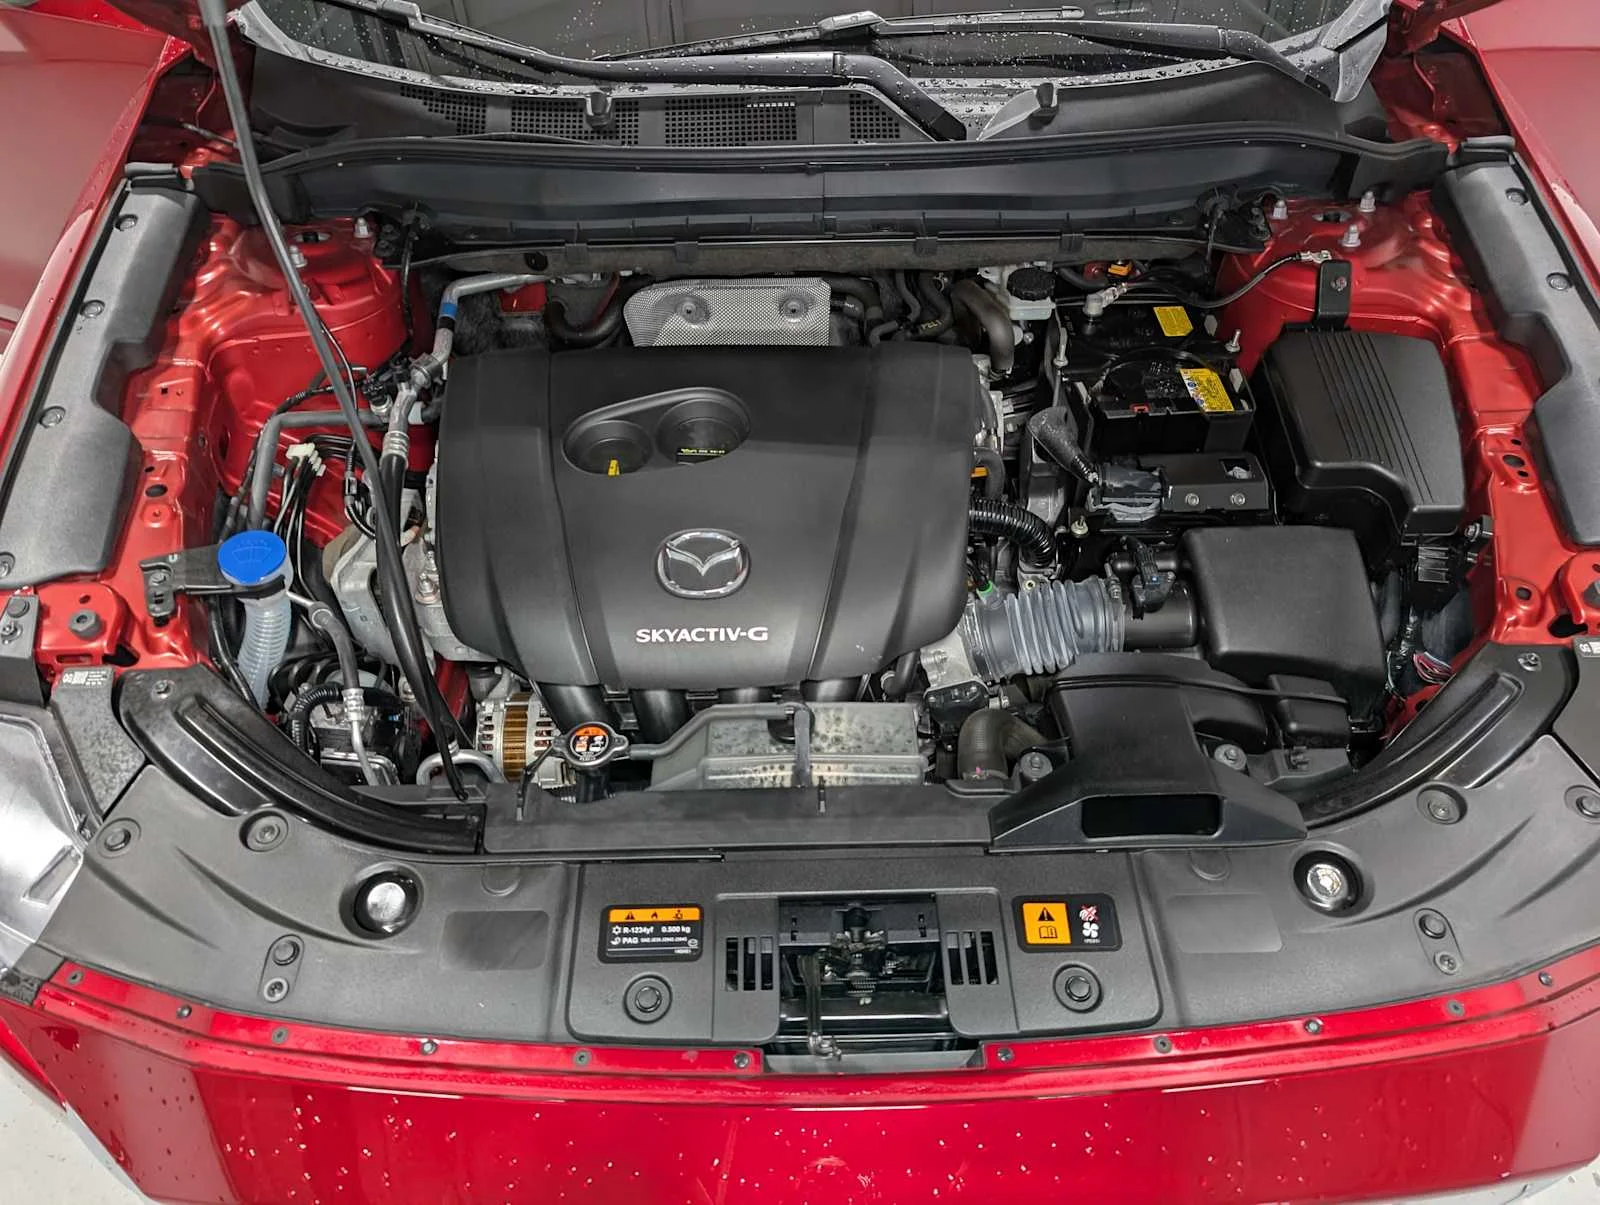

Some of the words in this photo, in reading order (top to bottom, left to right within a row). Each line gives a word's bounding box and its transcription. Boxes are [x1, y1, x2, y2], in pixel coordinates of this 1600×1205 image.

[636, 627, 769, 643] SKYACTIV-G
[622, 926, 654, 935] R-1234yf
[681, 926, 691, 934] kg
